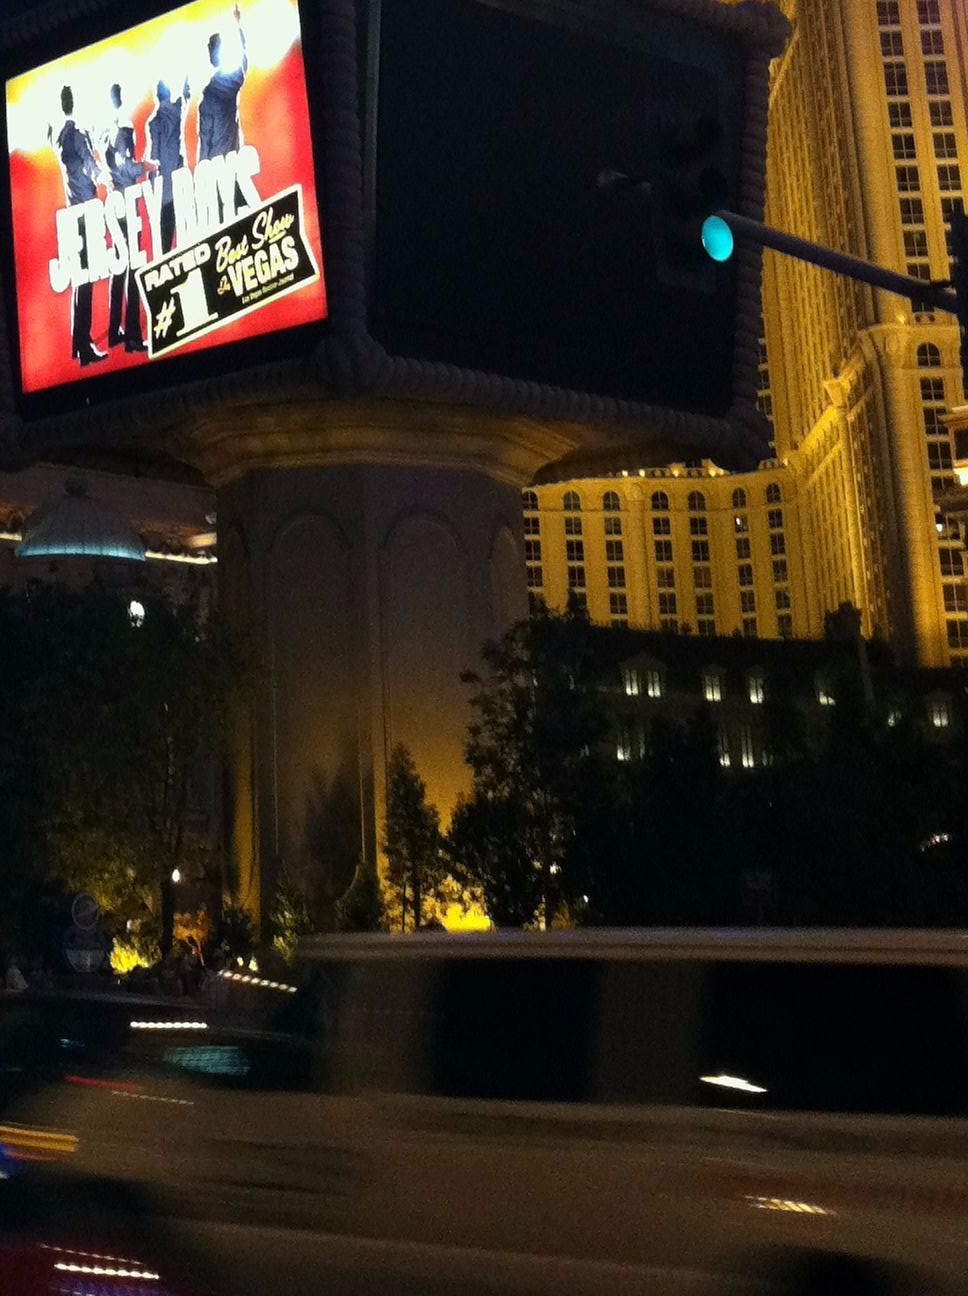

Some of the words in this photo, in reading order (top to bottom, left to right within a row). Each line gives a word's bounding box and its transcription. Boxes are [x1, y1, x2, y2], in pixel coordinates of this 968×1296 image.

[49, 176, 163, 294] JERSEY
[172, 145, 263, 252] BOYS
[215, 235, 250, 273] Best
[251, 206, 295, 250] Show
[144, 242, 212, 292] RATED
[227, 235, 300, 297] VEGAS
